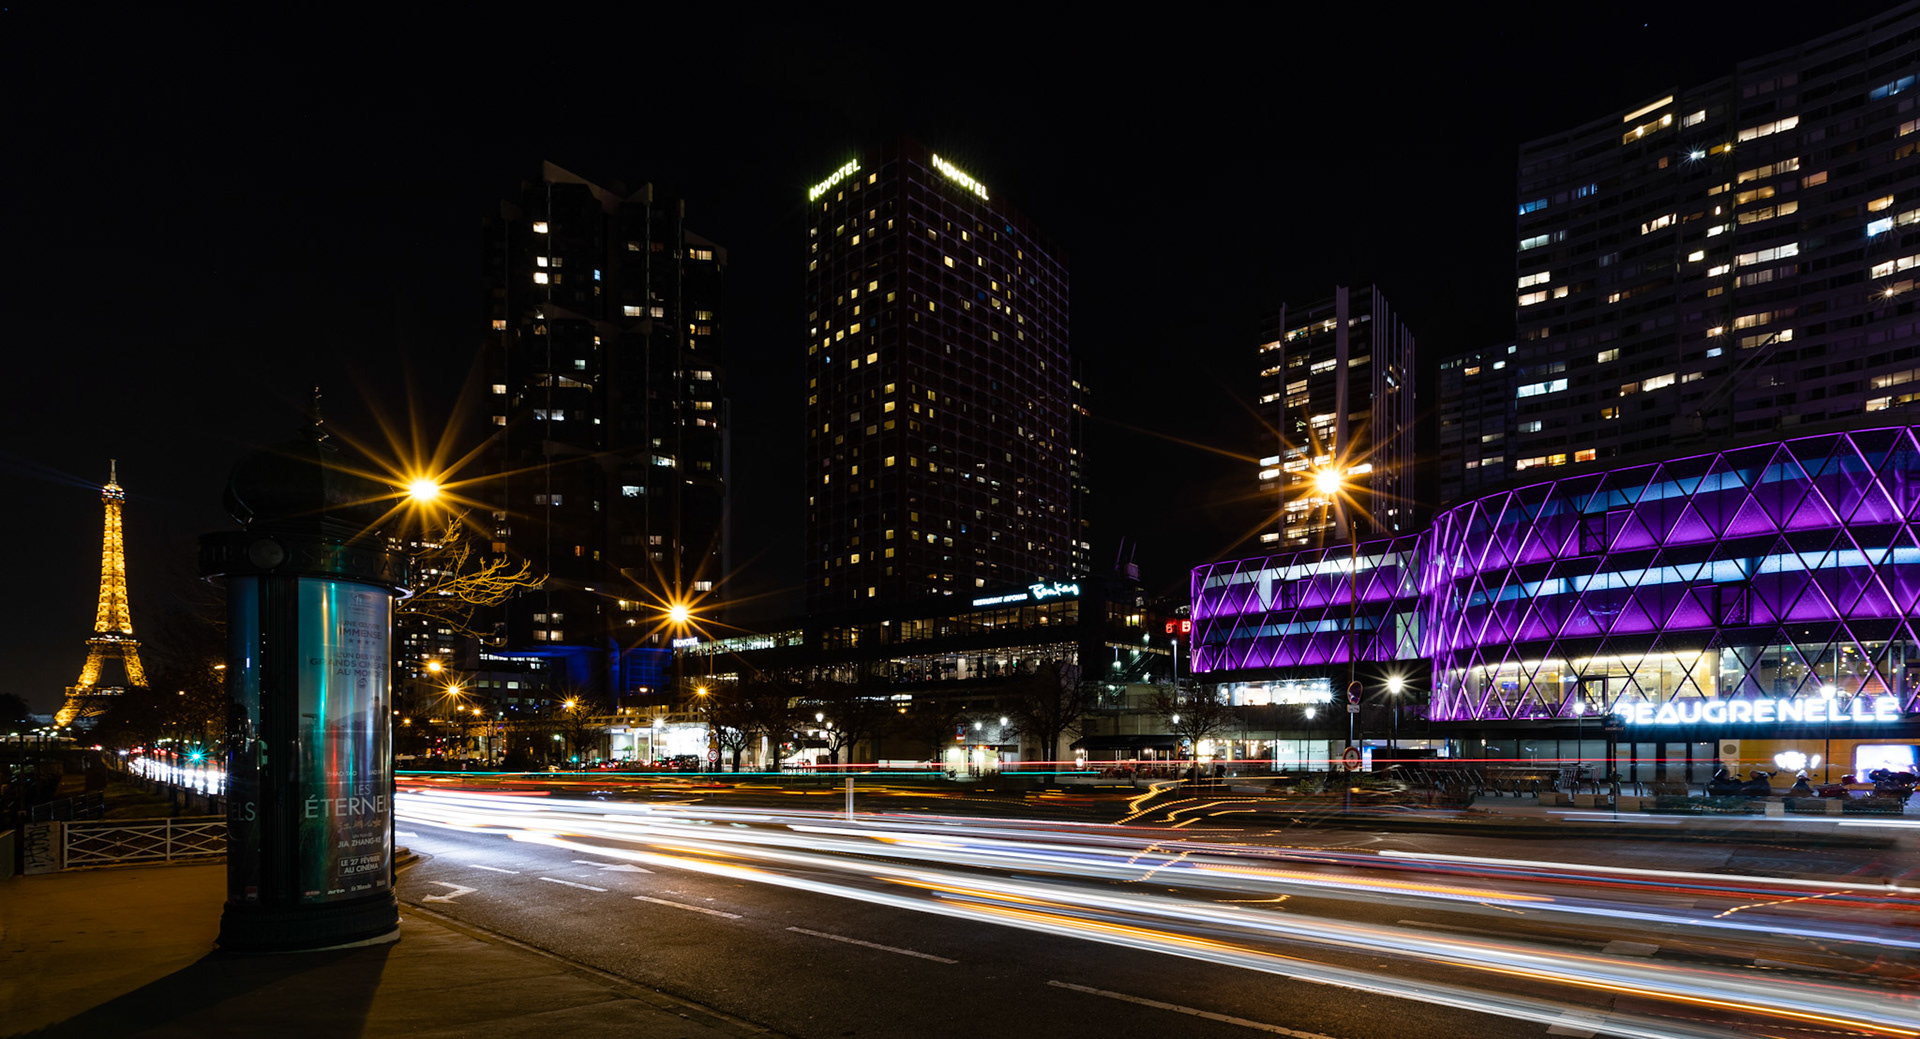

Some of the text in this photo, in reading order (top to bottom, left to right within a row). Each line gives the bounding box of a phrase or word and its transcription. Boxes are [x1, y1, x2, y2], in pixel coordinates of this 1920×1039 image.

[809, 158, 861, 202] NOVOTEL
[931, 153, 989, 201] NOVOTEL
[339, 627, 382, 640] IMMENSE
[672, 636, 699, 648] NOVOTEL
[310, 658, 357, 668] GRANDS
[336, 668, 352, 677] AU
[1613, 697, 1899, 724] BEAUGRENELLE
[353, 784, 373, 797] LES
[337, 836, 382, 849] JIA ZHANG-KE
[349, 857, 360, 867] 27
[360, 855, 381, 865] FÉVRIER
[344, 863, 379, 875] AU CINÉMA
